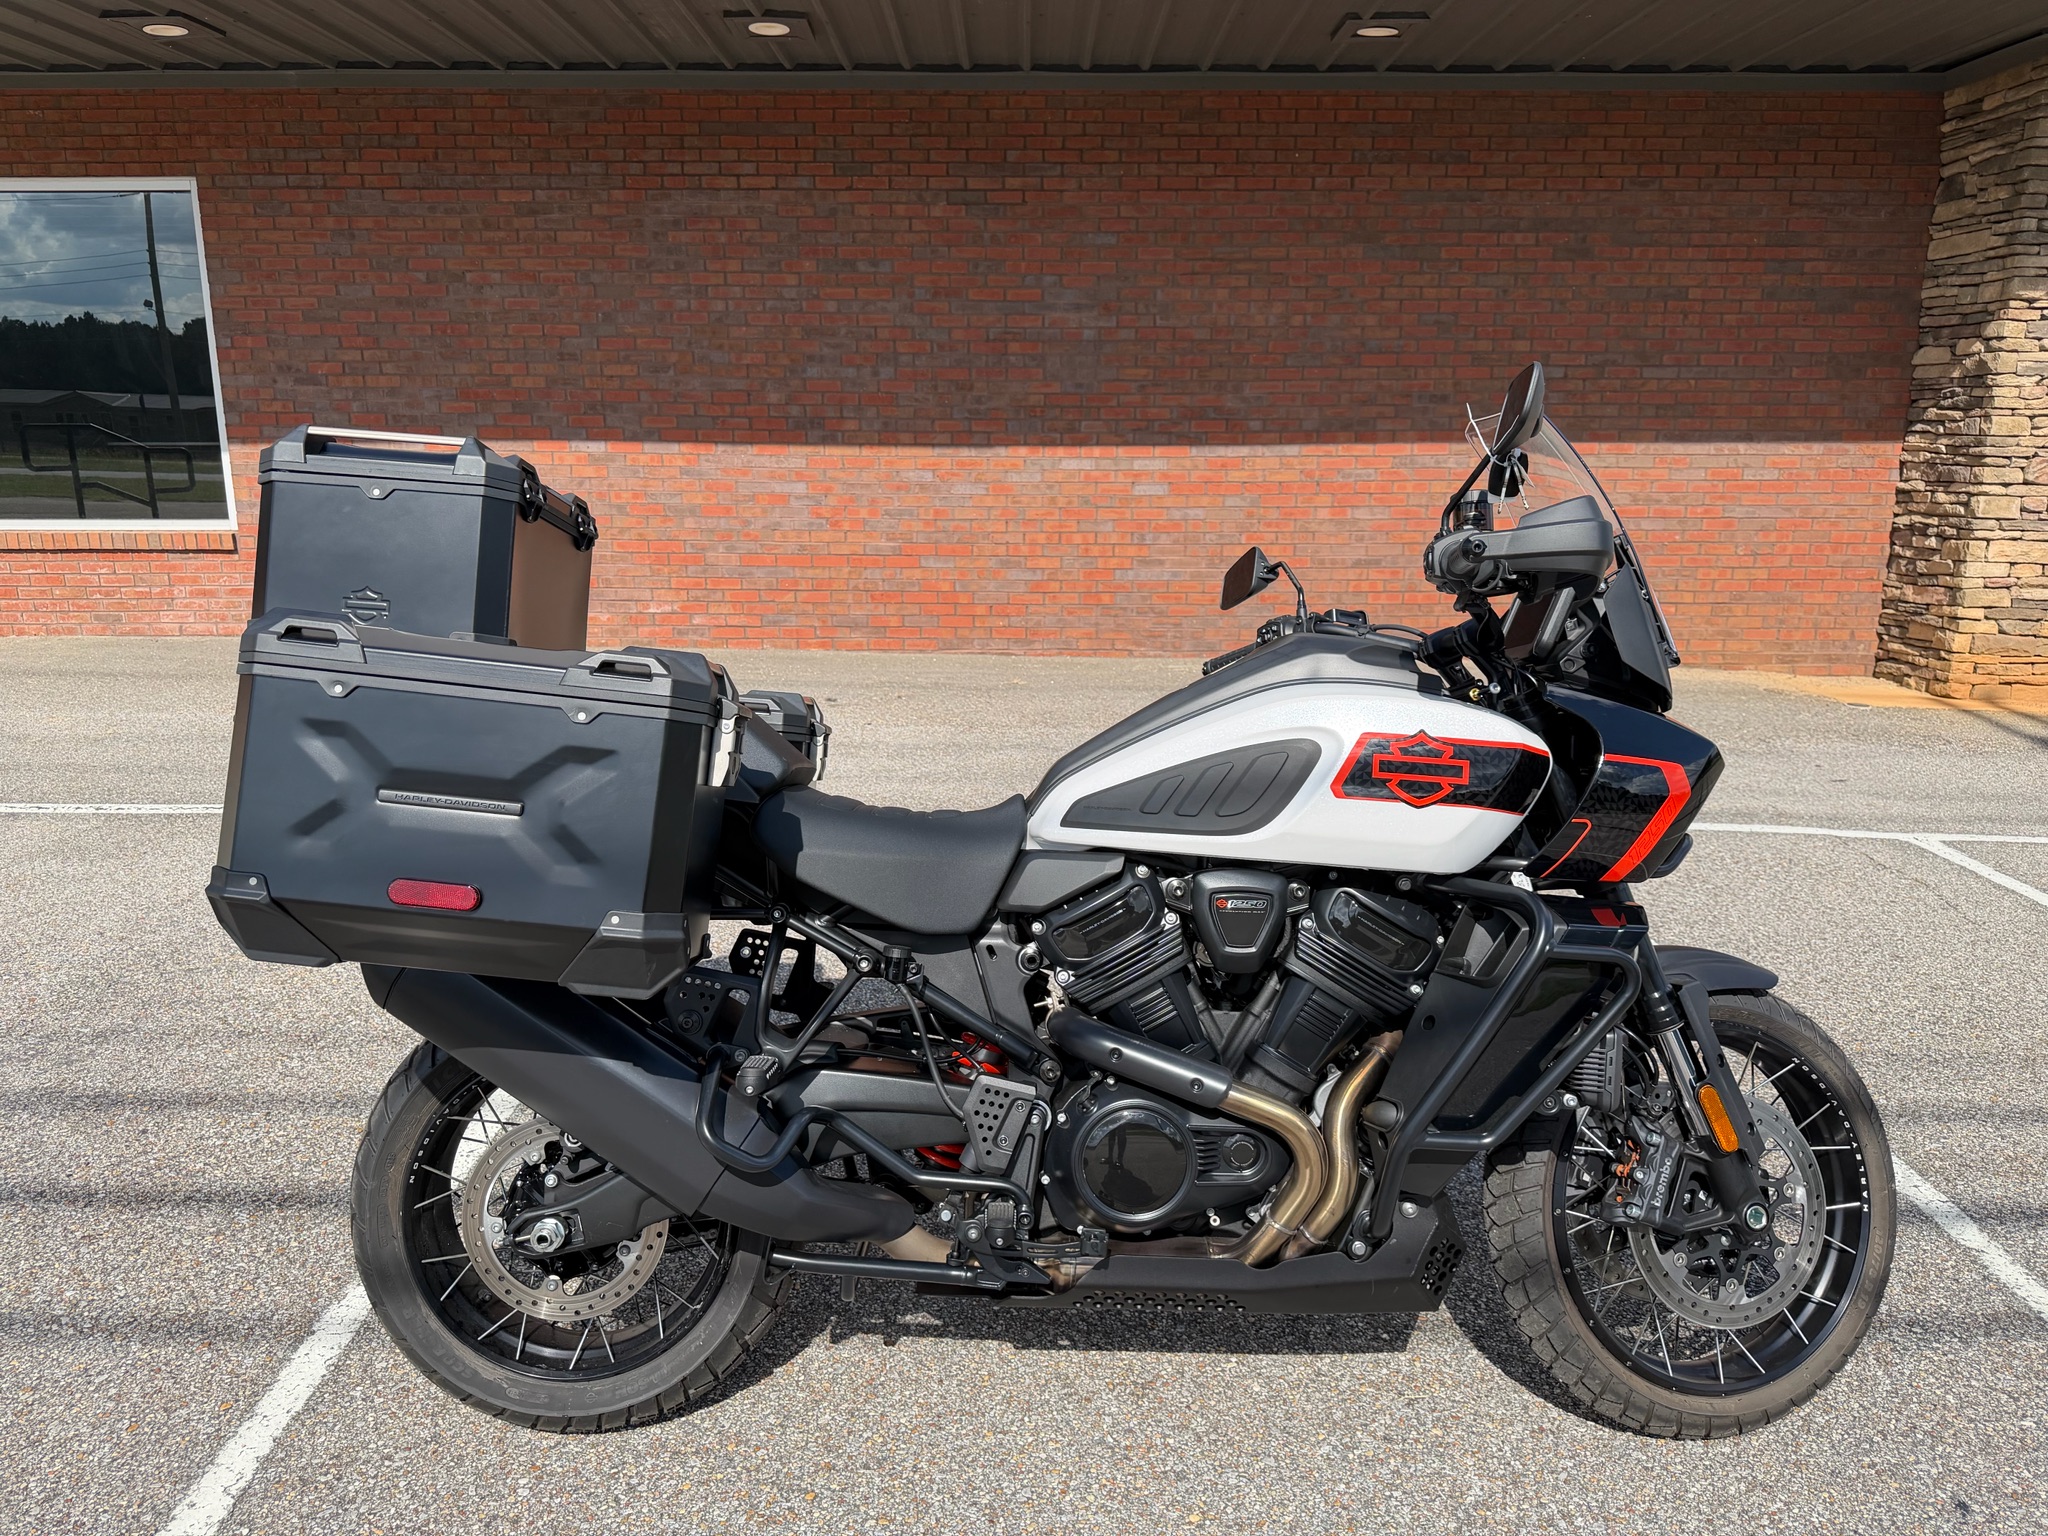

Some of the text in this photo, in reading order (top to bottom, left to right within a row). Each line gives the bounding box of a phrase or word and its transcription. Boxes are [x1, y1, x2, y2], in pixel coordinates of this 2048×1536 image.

[394, 793, 506, 810] HARLEY-DAVIDSON
[1628, 796, 1677, 865] 1250
[1228, 899, 1267, 909] 1250
[1791, 1056, 1869, 1212] HARLEY-DAVIDSON
[1650, 1156, 1673, 1207] brembo
